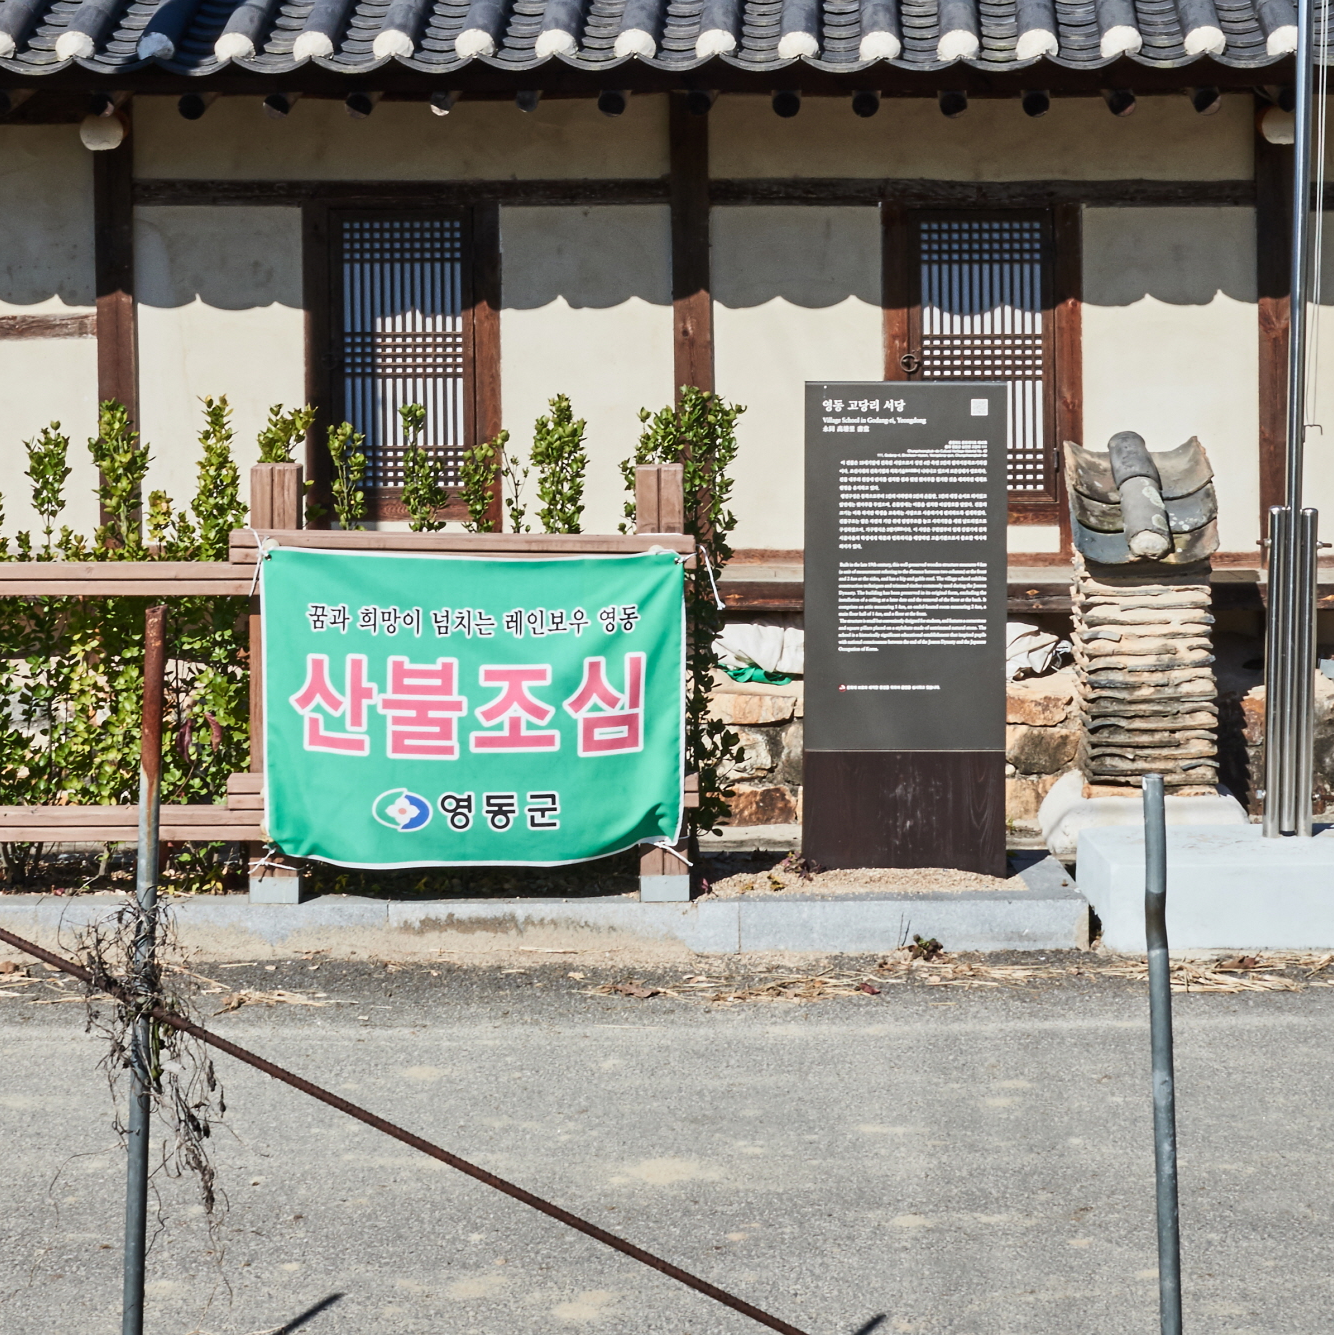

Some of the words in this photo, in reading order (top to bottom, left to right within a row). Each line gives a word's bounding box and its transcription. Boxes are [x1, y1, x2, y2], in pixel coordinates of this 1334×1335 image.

[822, 399, 845, 412] 영동
[847, 399, 880, 412] 고당리
[883, 399, 906, 412] 서당
[308, 604, 351, 633] 꿈과
[359, 605, 422, 636] 희망이
[432, 608, 496, 638] 넘치는
[504, 608, 590, 637] 레인보우
[598, 604, 640, 633] 영동
[290, 652, 646, 760] 산불조심
[438, 791, 560, 831] 영동군
